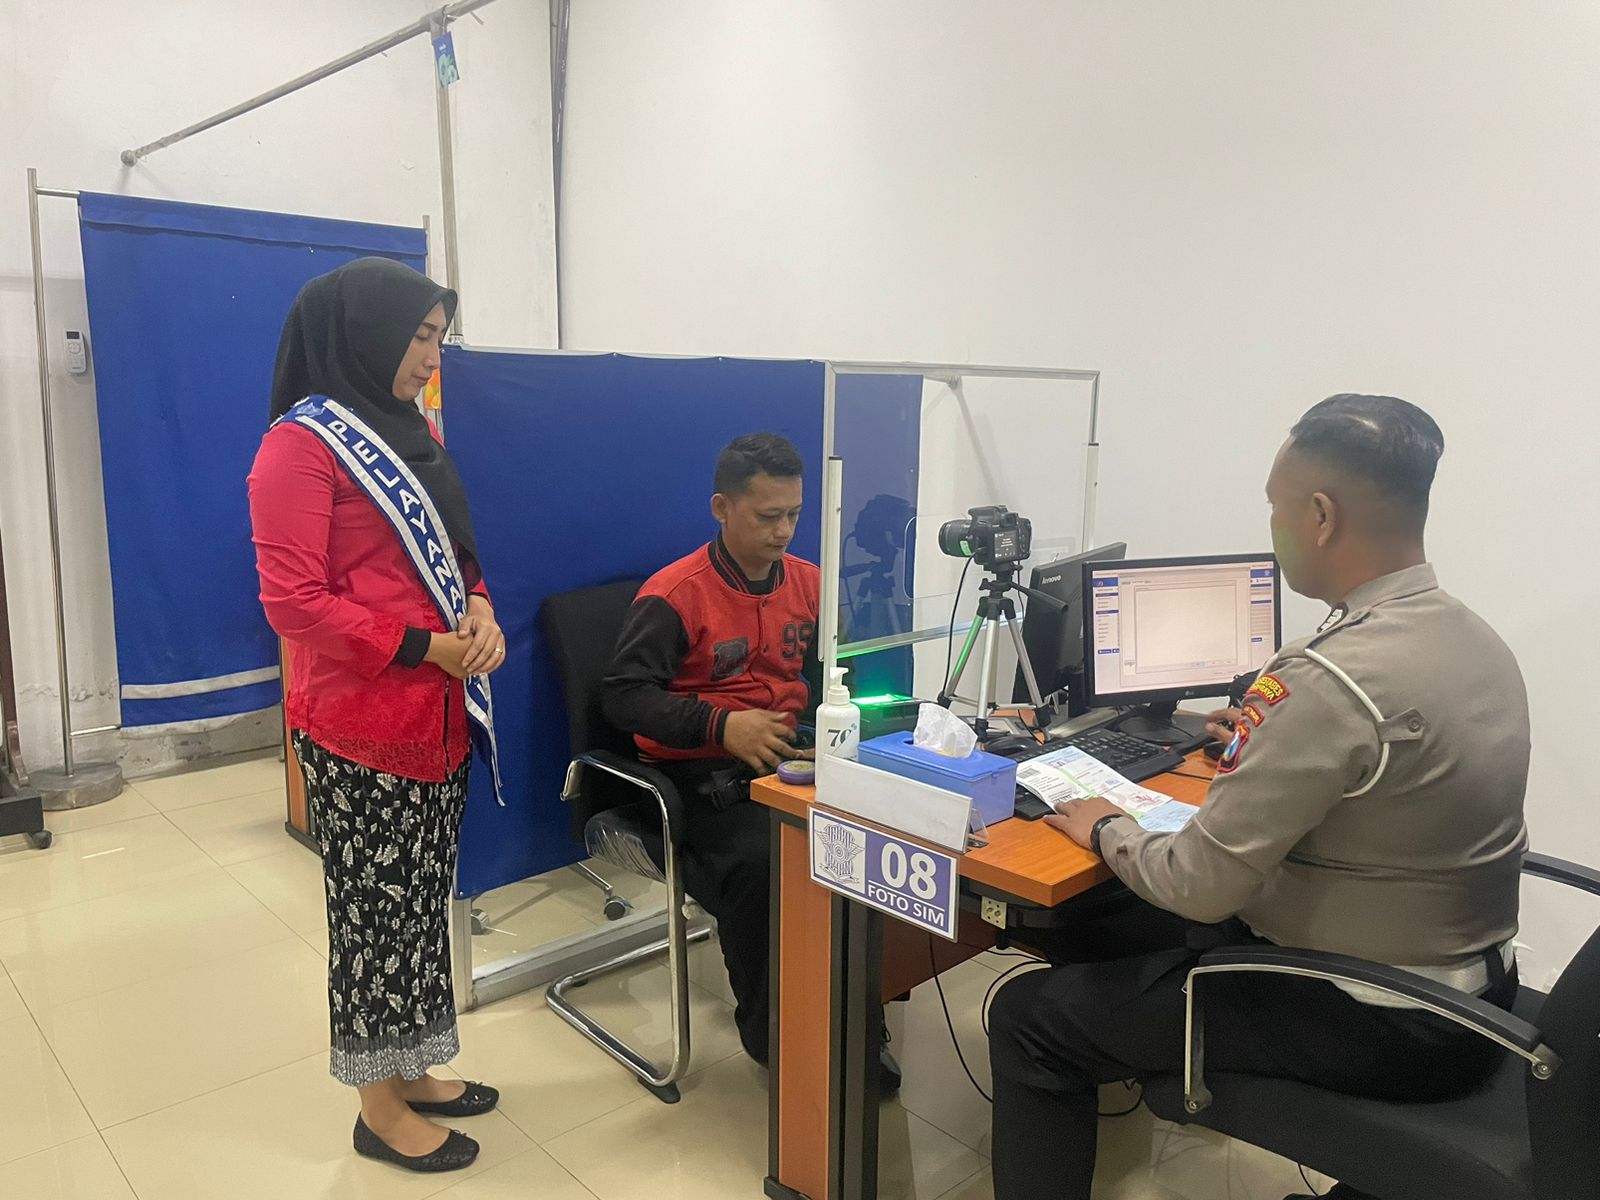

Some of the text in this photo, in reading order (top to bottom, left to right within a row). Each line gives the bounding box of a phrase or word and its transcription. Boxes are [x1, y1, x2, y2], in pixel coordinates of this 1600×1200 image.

[880, 842, 937, 900] 08
[867, 884, 945, 927] FOTO SIM
